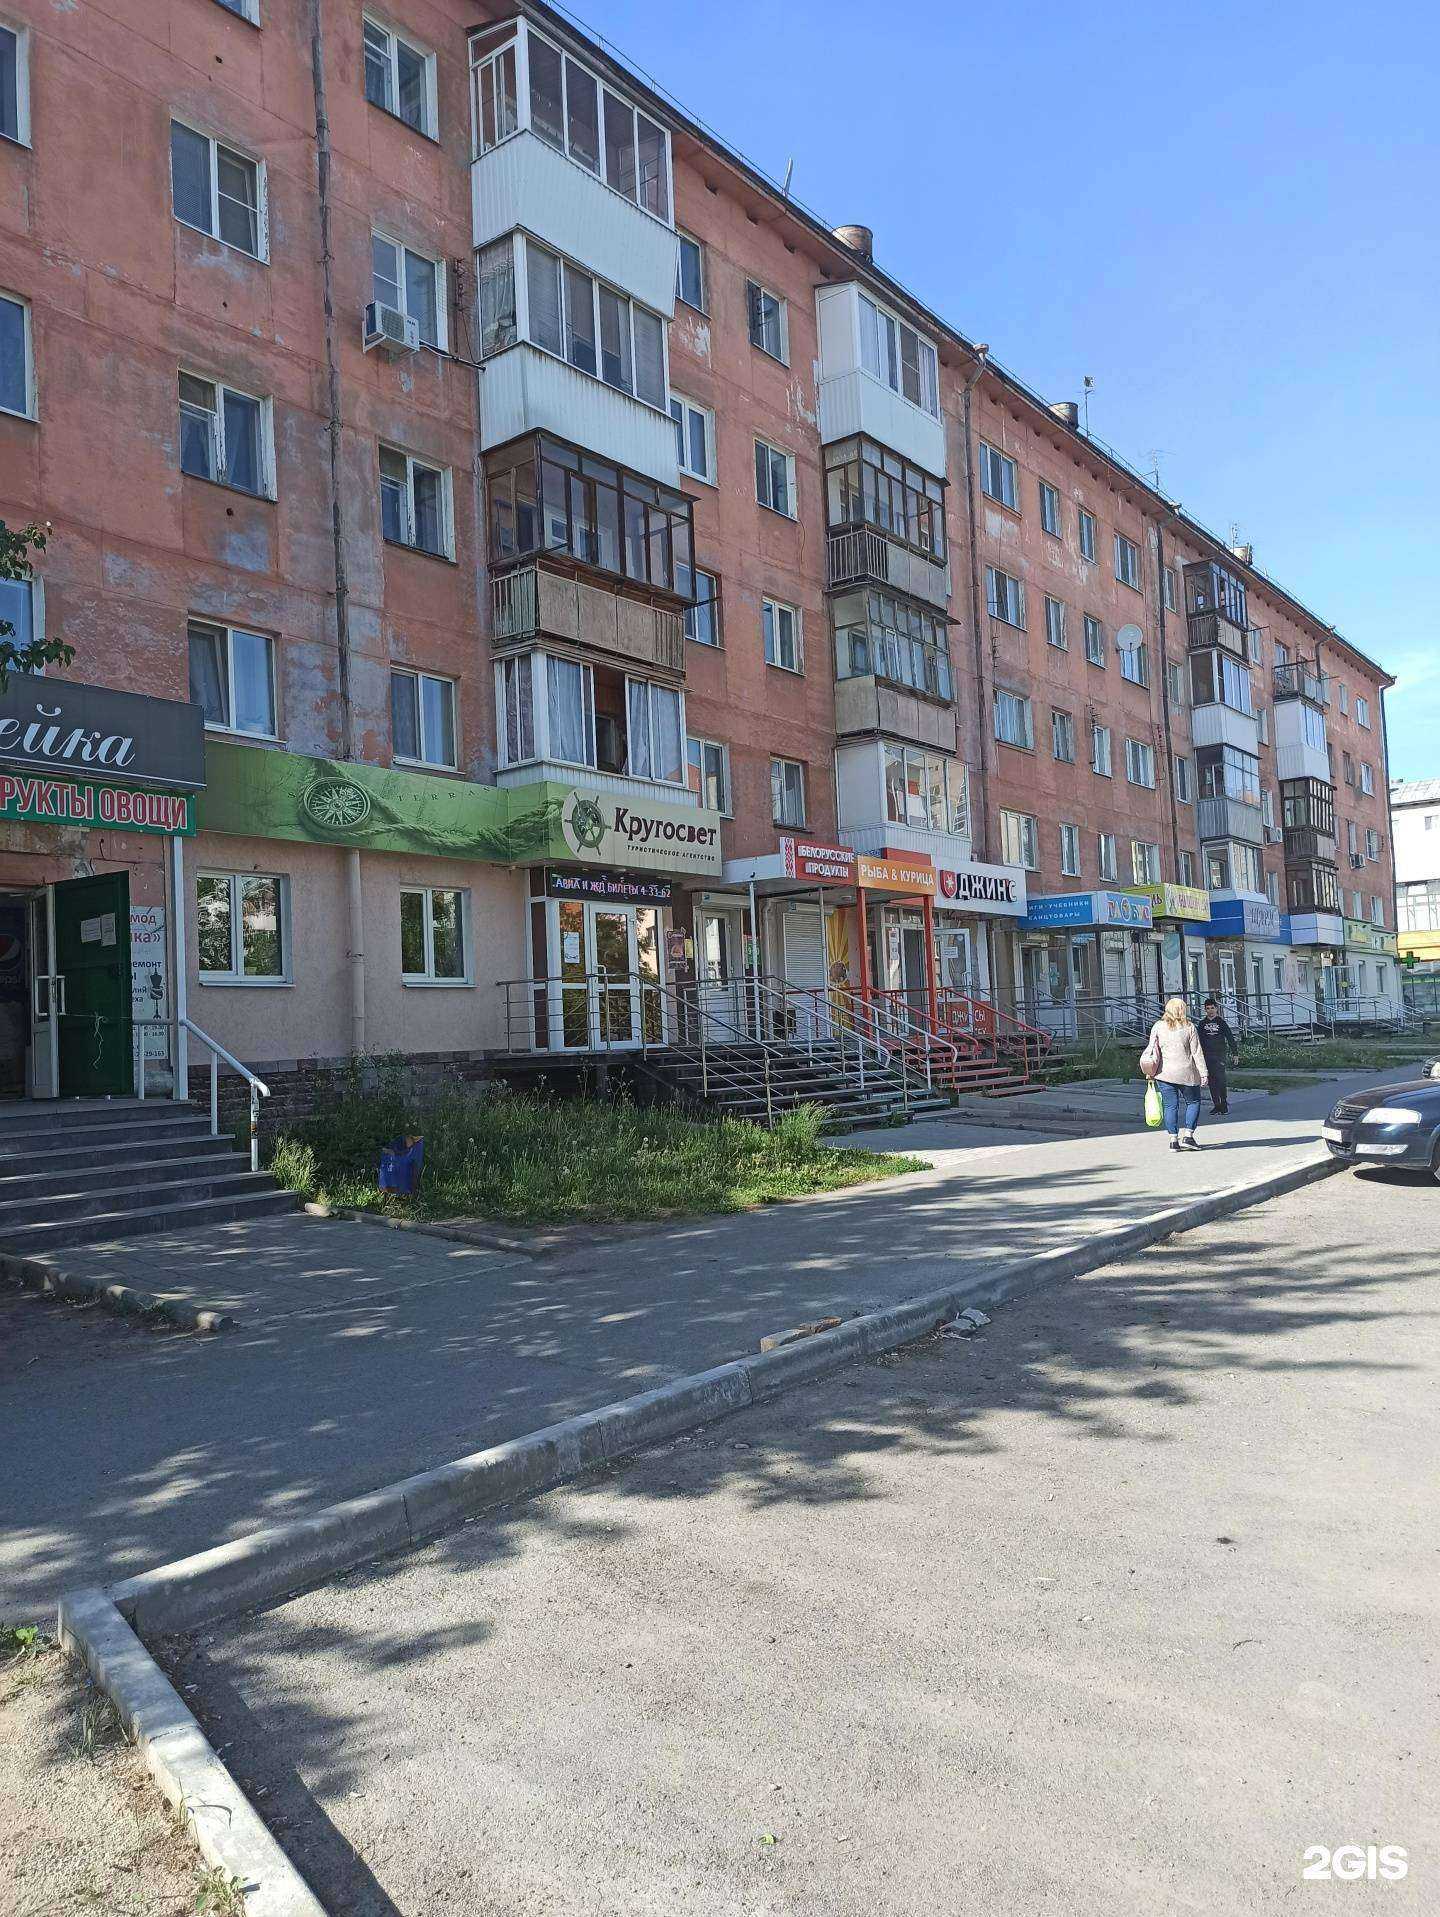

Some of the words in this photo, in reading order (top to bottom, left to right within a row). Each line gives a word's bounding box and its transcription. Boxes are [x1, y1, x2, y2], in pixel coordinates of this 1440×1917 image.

[99, 789, 188, 831] ОВОЩИ
[613, 807, 717, 846] Кругосвет
[627, 845, 680, 857] ТУРИСТИЧЕСКОЕ
[682, 852, 715, 861] АГЕНТСТВО
[798, 846, 855, 863] БЕЛОРУССКИЕ
[805, 862, 849, 878] ПРОДУКТЫ
[860, 864, 889, 880] РЫБА
[891, 868, 898, 880] &
[900, 870, 935, 886] КУРИЦА
[582, 881, 588, 891] И
[607, 881, 640, 896] БИЛЕТЫ
[640, 885, 672, 898] 4-33-62
[1048, 900, 1089, 910] УЧЕБНИКИ
